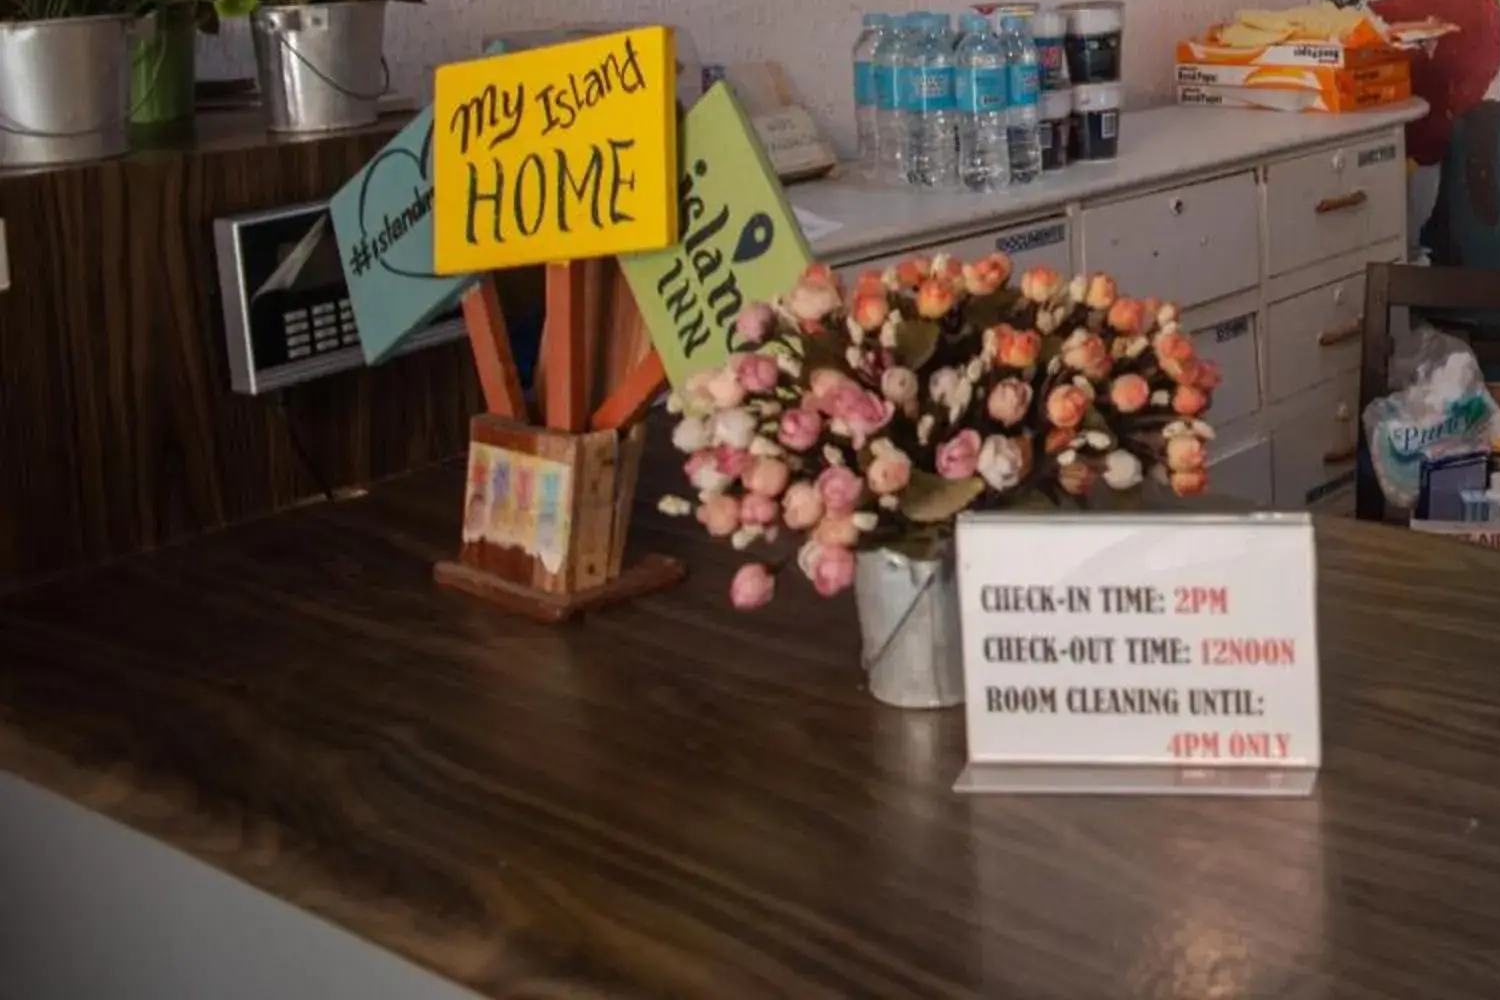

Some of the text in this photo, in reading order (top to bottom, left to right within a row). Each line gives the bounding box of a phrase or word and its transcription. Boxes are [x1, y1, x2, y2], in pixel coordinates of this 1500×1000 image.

[535, 36, 646, 135] Island
[465, 138, 636, 245] HOME
[981, 585, 1228, 614] CHECK-IN TIME: 2PM
[983, 636, 1296, 665] CHECK-OUT TIME: 12NOON
[986, 686, 1264, 716] ROOM CLEANING UNTIL:
[1167, 731, 1290, 758] 4PM ONLY
